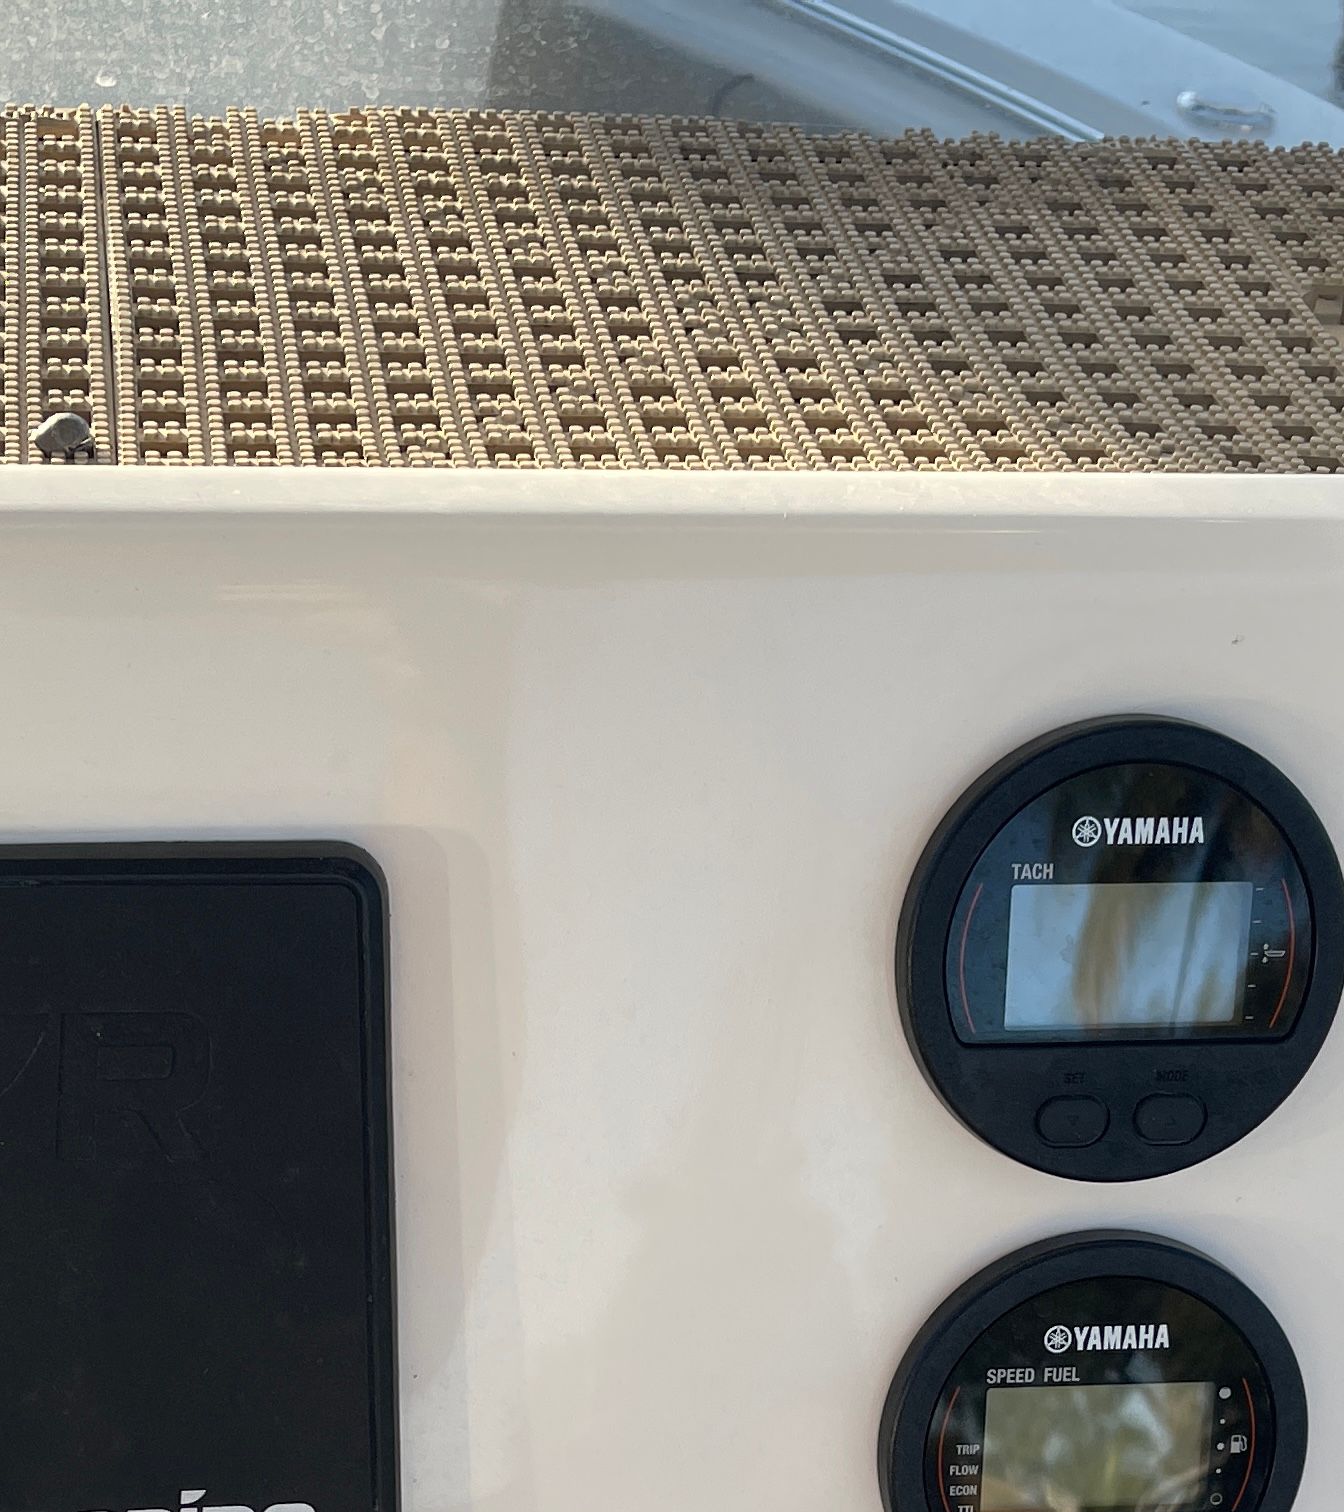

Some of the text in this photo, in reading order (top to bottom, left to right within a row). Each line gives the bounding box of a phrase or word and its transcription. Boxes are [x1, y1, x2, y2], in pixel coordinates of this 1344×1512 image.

[1103, 816, 1205, 845] YAMAHA
[1011, 863, 1055, 880] TACH
[1074, 1324, 1170, 1351] YAMAHA
[986, 1367, 1081, 1384] SPEED FUEL
[956, 1444, 981, 1456] TRIP
[949, 1464, 979, 1477] FLOW
[949, 1484, 978, 1498] ECON
